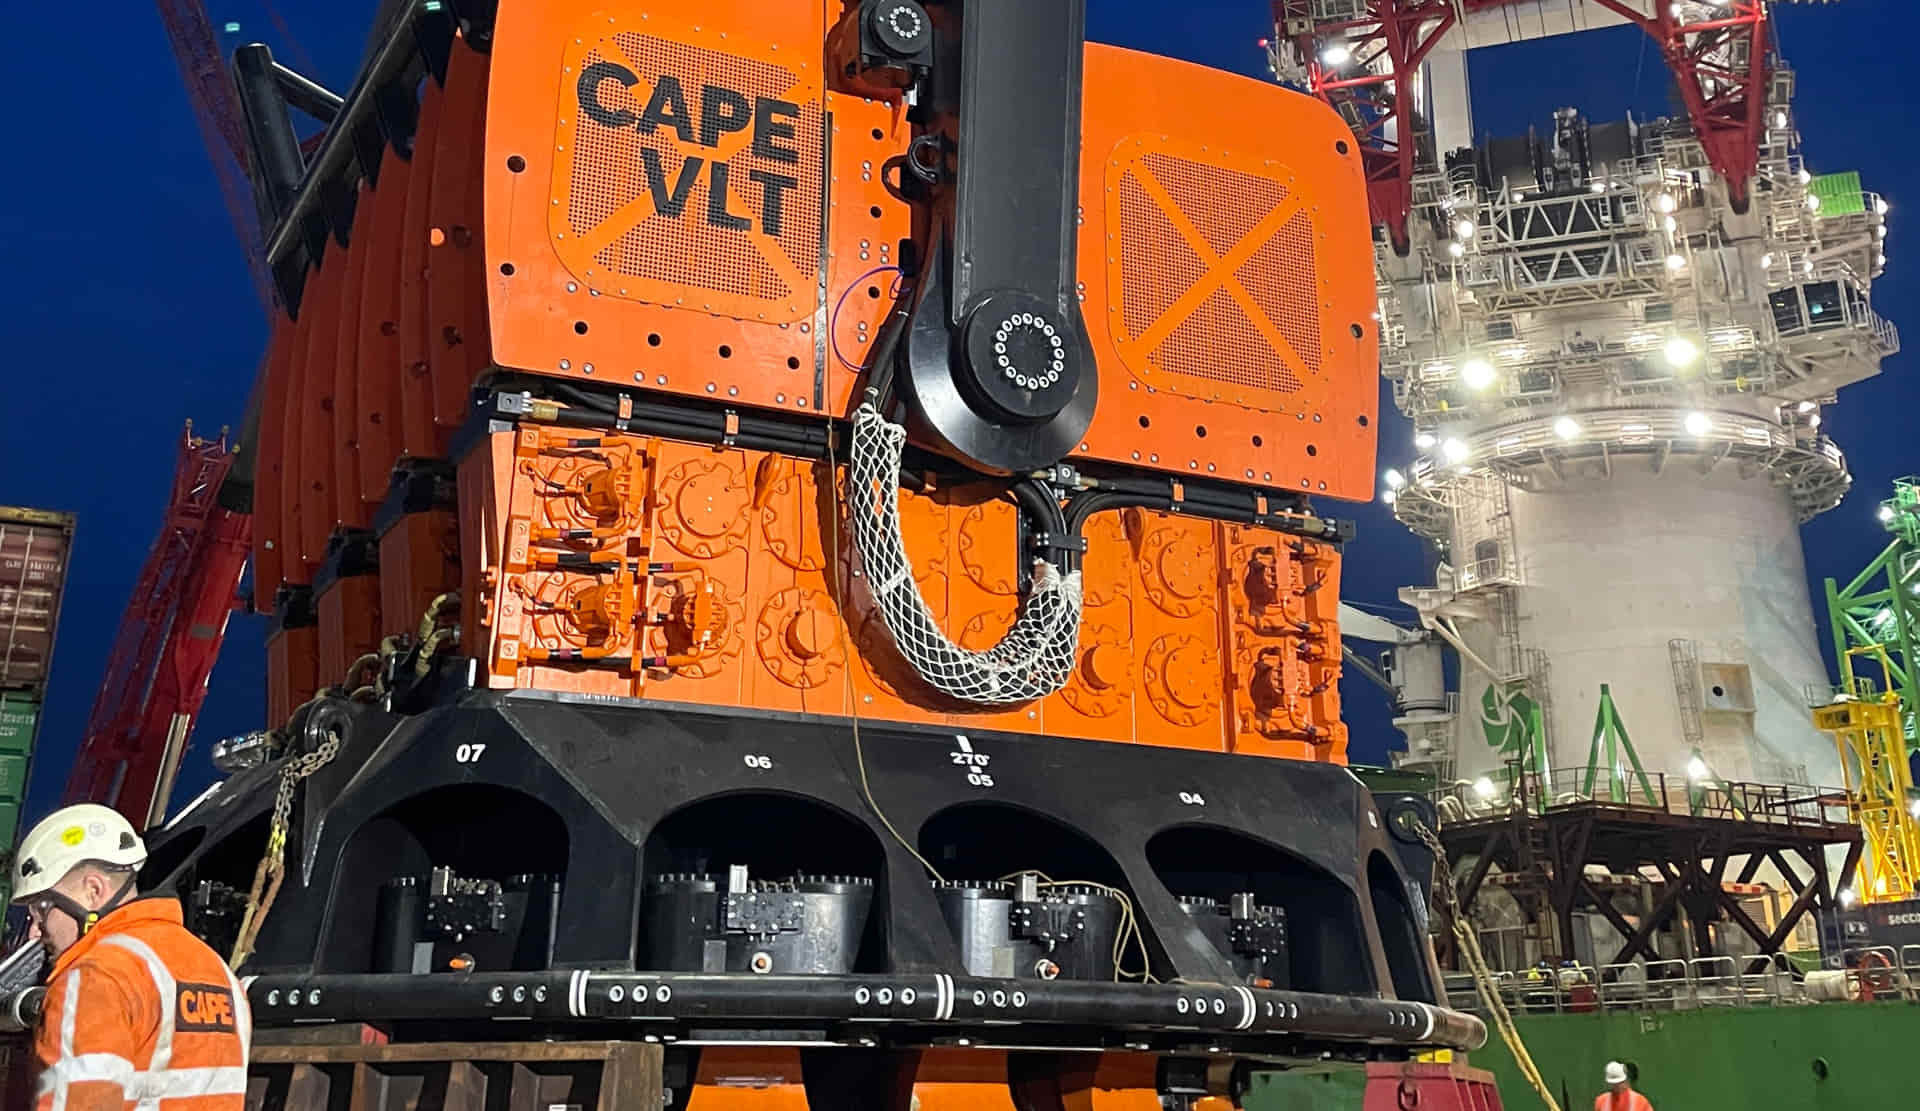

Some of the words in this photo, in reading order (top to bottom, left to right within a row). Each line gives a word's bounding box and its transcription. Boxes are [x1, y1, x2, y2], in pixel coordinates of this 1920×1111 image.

[576, 61, 800, 165] CAPE
[639, 146, 799, 238] VLT
[456, 743, 486, 763] 07
[744, 754, 772, 769] 06
[967, 773, 994, 787] 05
[1179, 791, 1205, 806] 04
[180, 990, 233, 1025] CAPE
